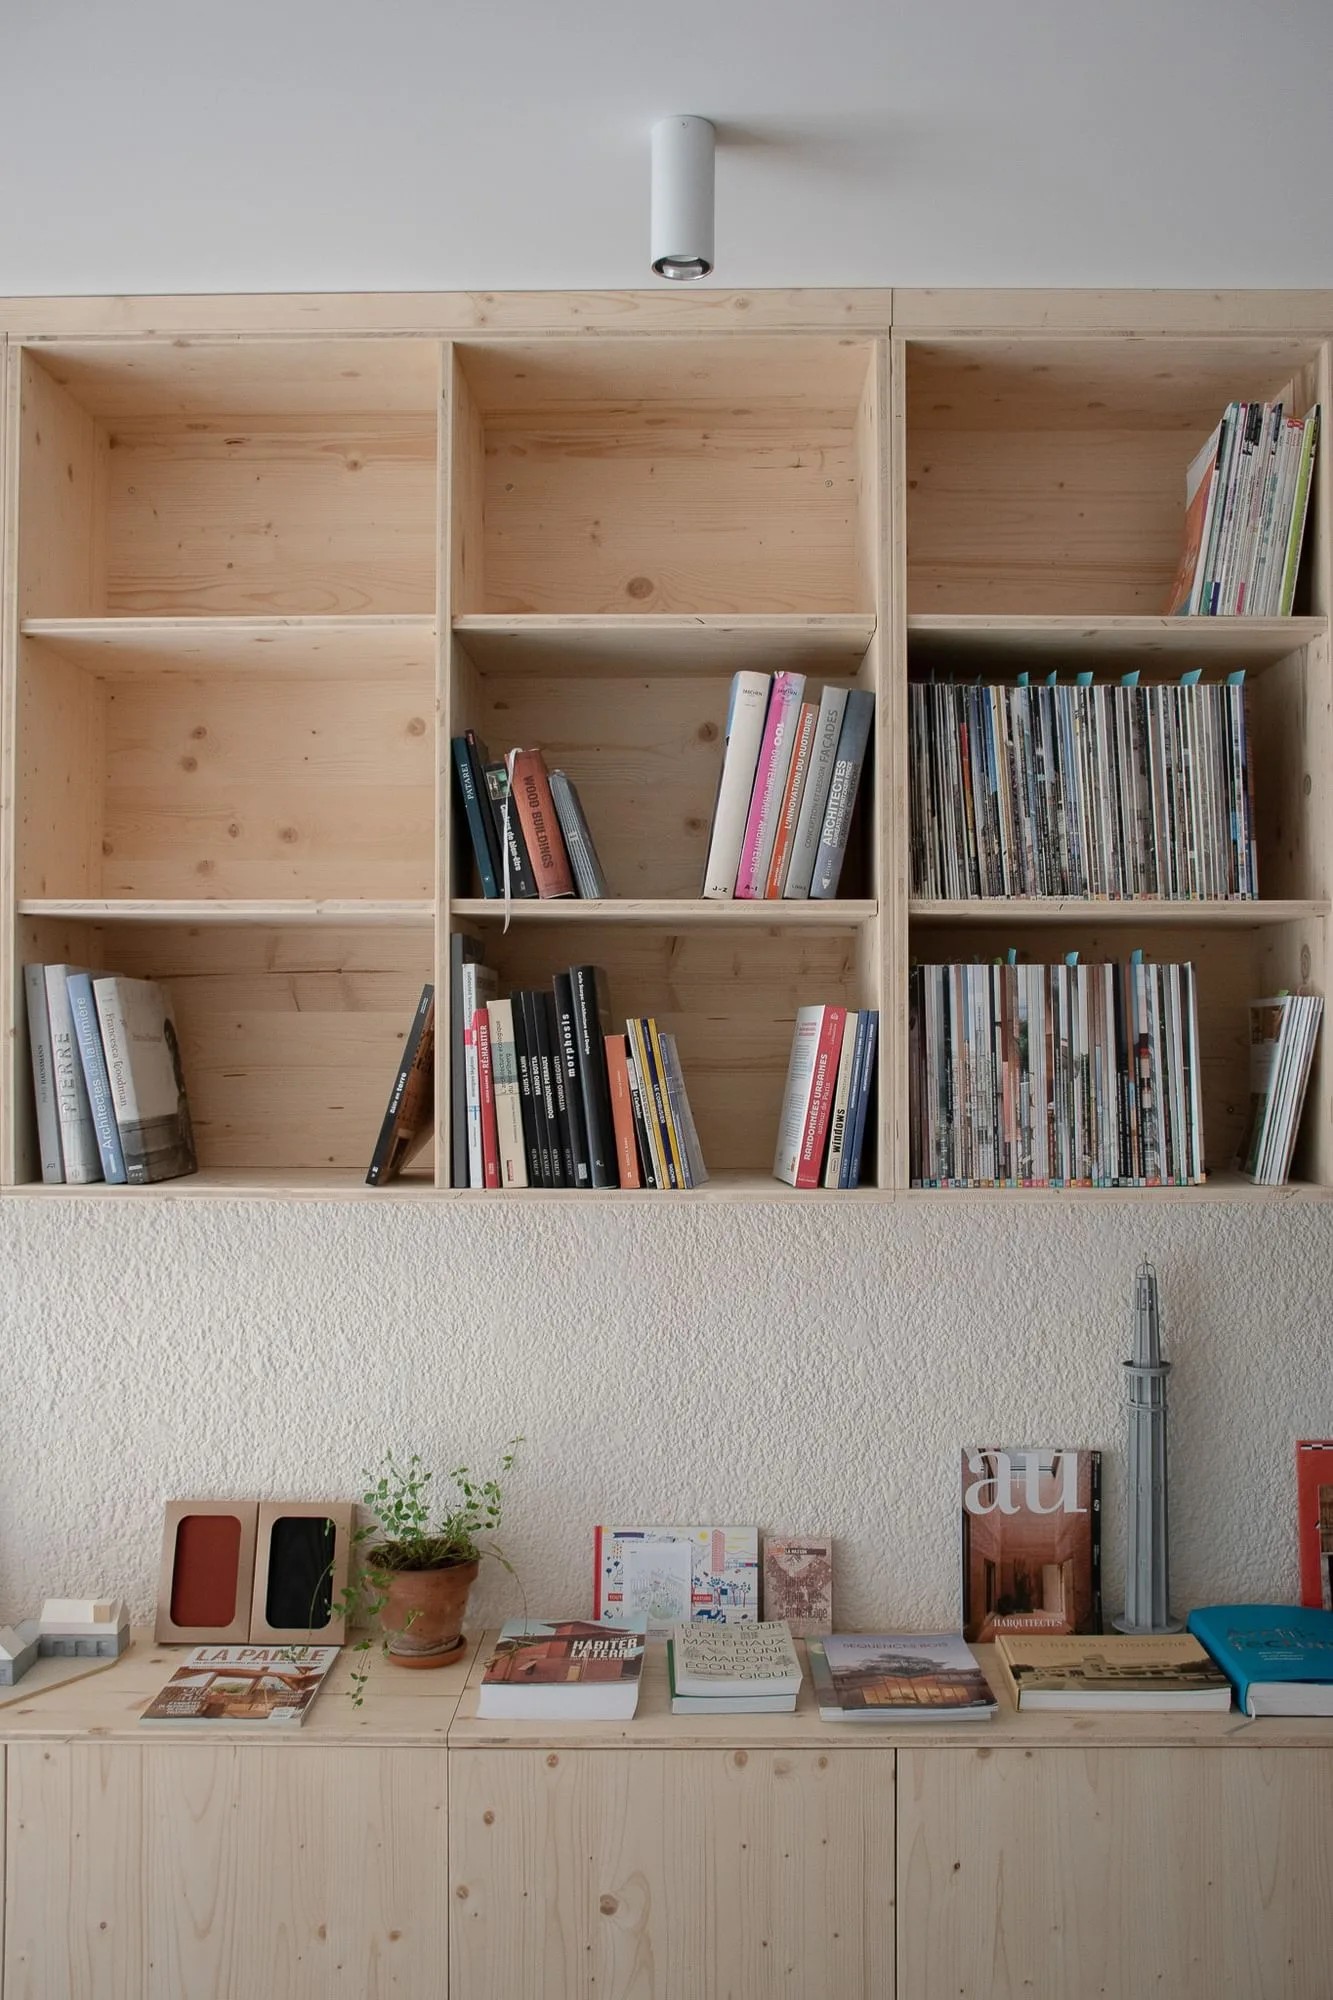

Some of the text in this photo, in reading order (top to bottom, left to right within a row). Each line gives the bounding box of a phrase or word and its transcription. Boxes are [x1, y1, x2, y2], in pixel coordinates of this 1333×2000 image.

[461, 763, 475, 800] PATAREI
[784, 712, 813, 829] L'INNOVATION DU QUOTIDIEN
[805, 804, 818, 848] CONCEPTION
[820, 709, 838, 764] FAÇADES
[750, 722, 785, 873] 100 CONTEMPORARY ARCHITECTS
[822, 760, 847, 847] ARCHITECTES
[523, 774, 554, 869] WOOD BUILDINGS
[508, 840, 521, 872] bien-être
[76, 997, 94, 1048] lumière
[580, 1001, 588, 1029] Architecture
[84, 1047, 96, 1059] la
[104, 1013, 120, 1059] Francesca
[479, 1025, 490, 1070] RÉ:HABITER
[562, 1013, 576, 1077] morphosis
[36, 1044, 47, 1085] HAUSSMANN
[54, 1033, 78, 1114] PIERRE
[87, 1059, 99, 1076] de
[396, 1072, 407, 1093] terre
[531, 1056, 542, 1095] MARIO BOTTA
[554, 1056, 566, 1111] VITTORIO GREGOTTI
[541, 1056, 554, 1119] DOMINIQUE PERRAULT
[633, 1095, 642, 1120] Corbusier
[653, 1084, 660, 1092] LE
[655, 1092, 666, 1124] CORBUSIER
[804, 1099, 820, 1161] RANDONNÉES
[814, 1053, 828, 1099] URBAINES
[90, 1077, 114, 1149] Architectes
[817, 1082, 831, 1135] autour de Paris
[832, 1109, 846, 1153] windows
[965, 1451, 1088, 1515] au
[699, 1631, 732, 1639] DES
[741, 1623, 783, 1631] TOUR
[993, 1618, 1063, 1628] HARQUITECTES
[195, 1648, 329, 1661] LA PAILE
[570, 1648, 637, 1658] LA TERRE
[572, 1638, 638, 1650] HABITER
[740, 1671, 793, 1679] GIQUE
